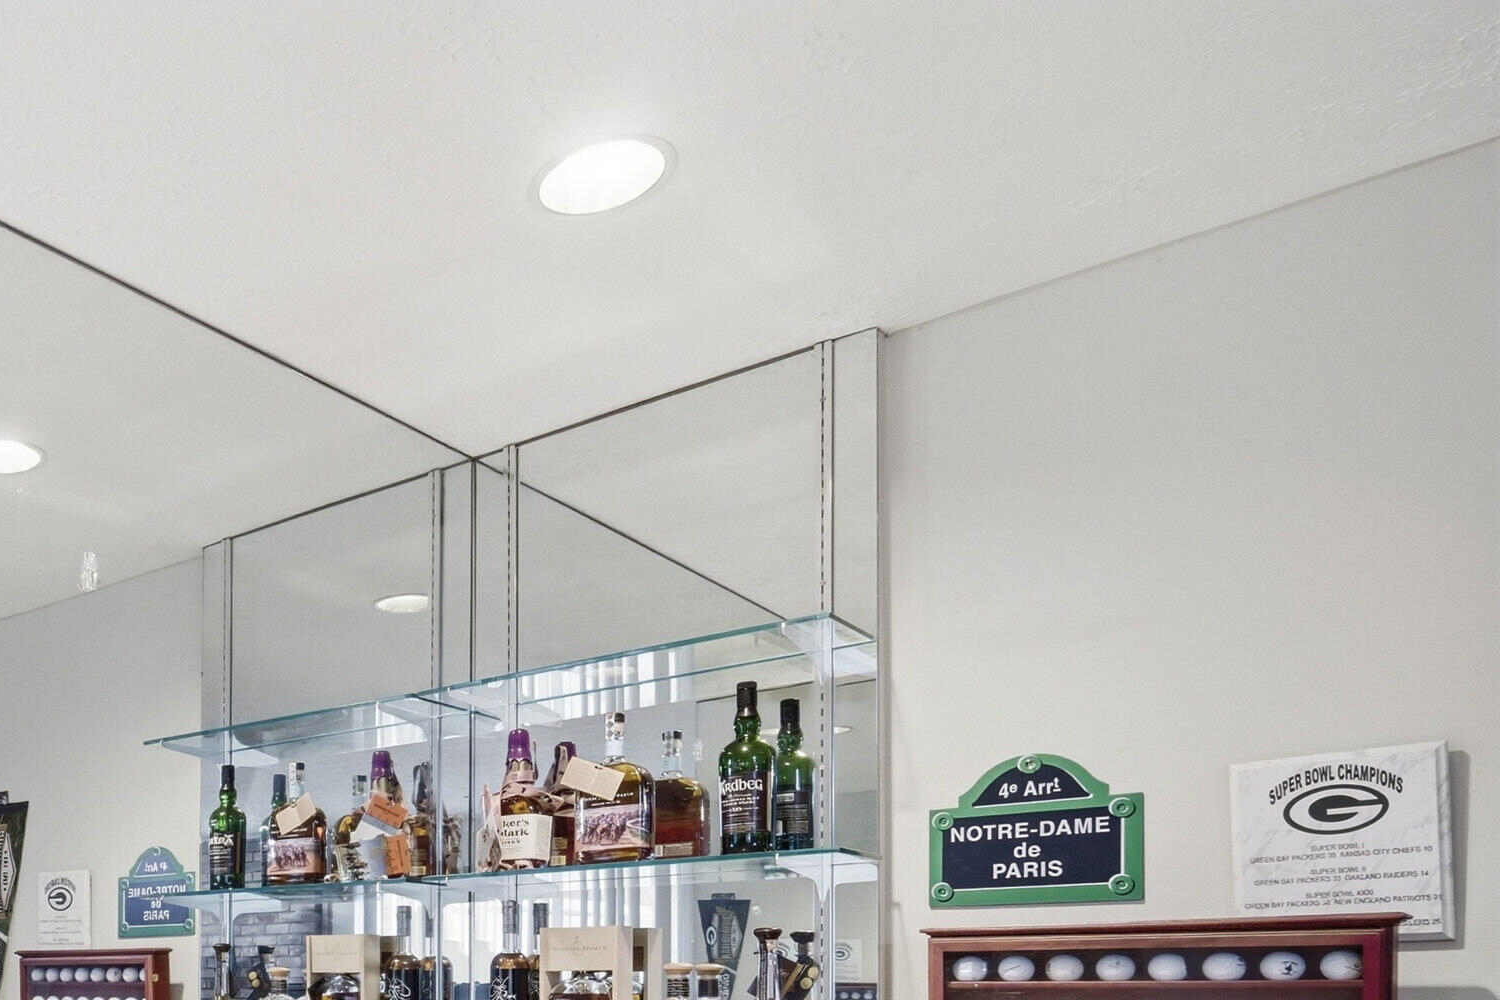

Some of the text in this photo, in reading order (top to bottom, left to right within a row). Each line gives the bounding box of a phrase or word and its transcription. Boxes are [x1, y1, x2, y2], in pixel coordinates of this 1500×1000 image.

[1268, 763, 1404, 805] SUPER BOWL CHAMPIONS
[950, 815, 1111, 843] NOTRE-DAME
[1013, 842, 1041, 859] de
[1249, 856, 1275, 864] GREEN
[1372, 848, 1390, 856] CITY
[1392, 846, 1421, 854] CHIEFS
[992, 860, 1063, 879] PARIS
